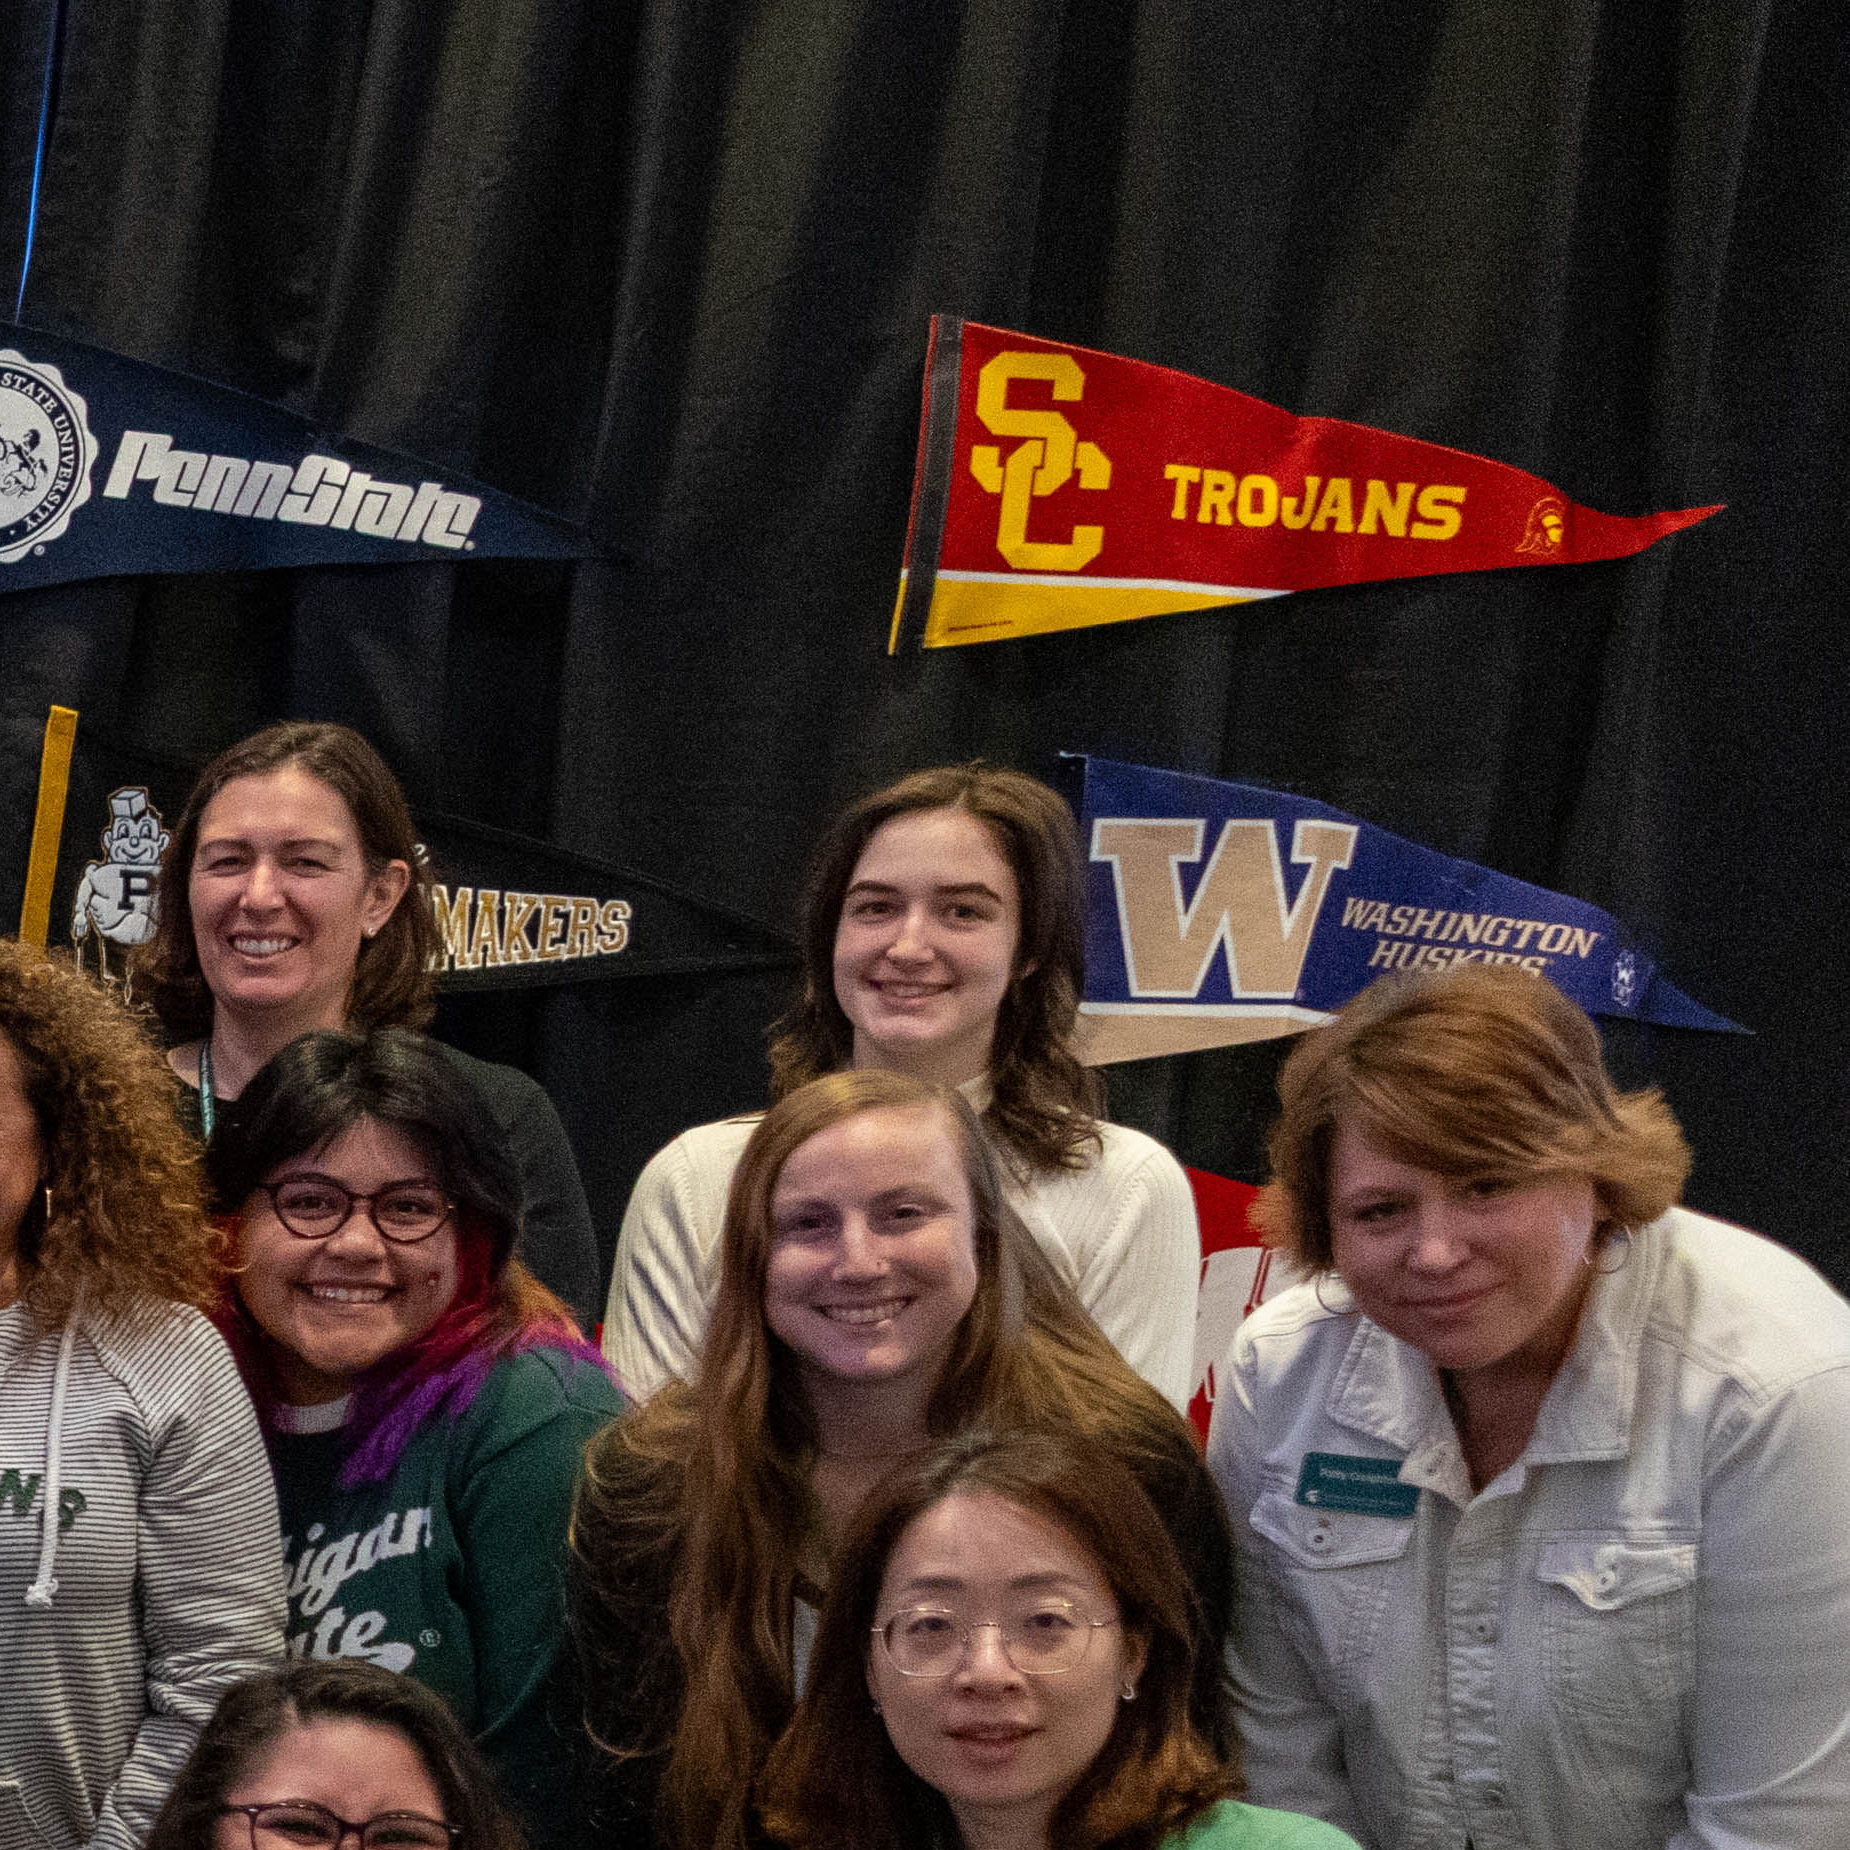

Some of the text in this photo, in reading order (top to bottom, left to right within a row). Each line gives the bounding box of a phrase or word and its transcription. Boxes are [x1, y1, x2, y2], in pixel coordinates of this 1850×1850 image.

[1, 372, 55, 413] STATE
[23, 413, 75, 531] UNIVERSITY
[1164, 464, 1466, 542] TROJANS
[428, 884, 632, 971] MAKERS
[1089, 816, 1359, 998] W
[1341, 897, 1602, 959] WASHINGTON
[282, 1506, 433, 1616] igan
